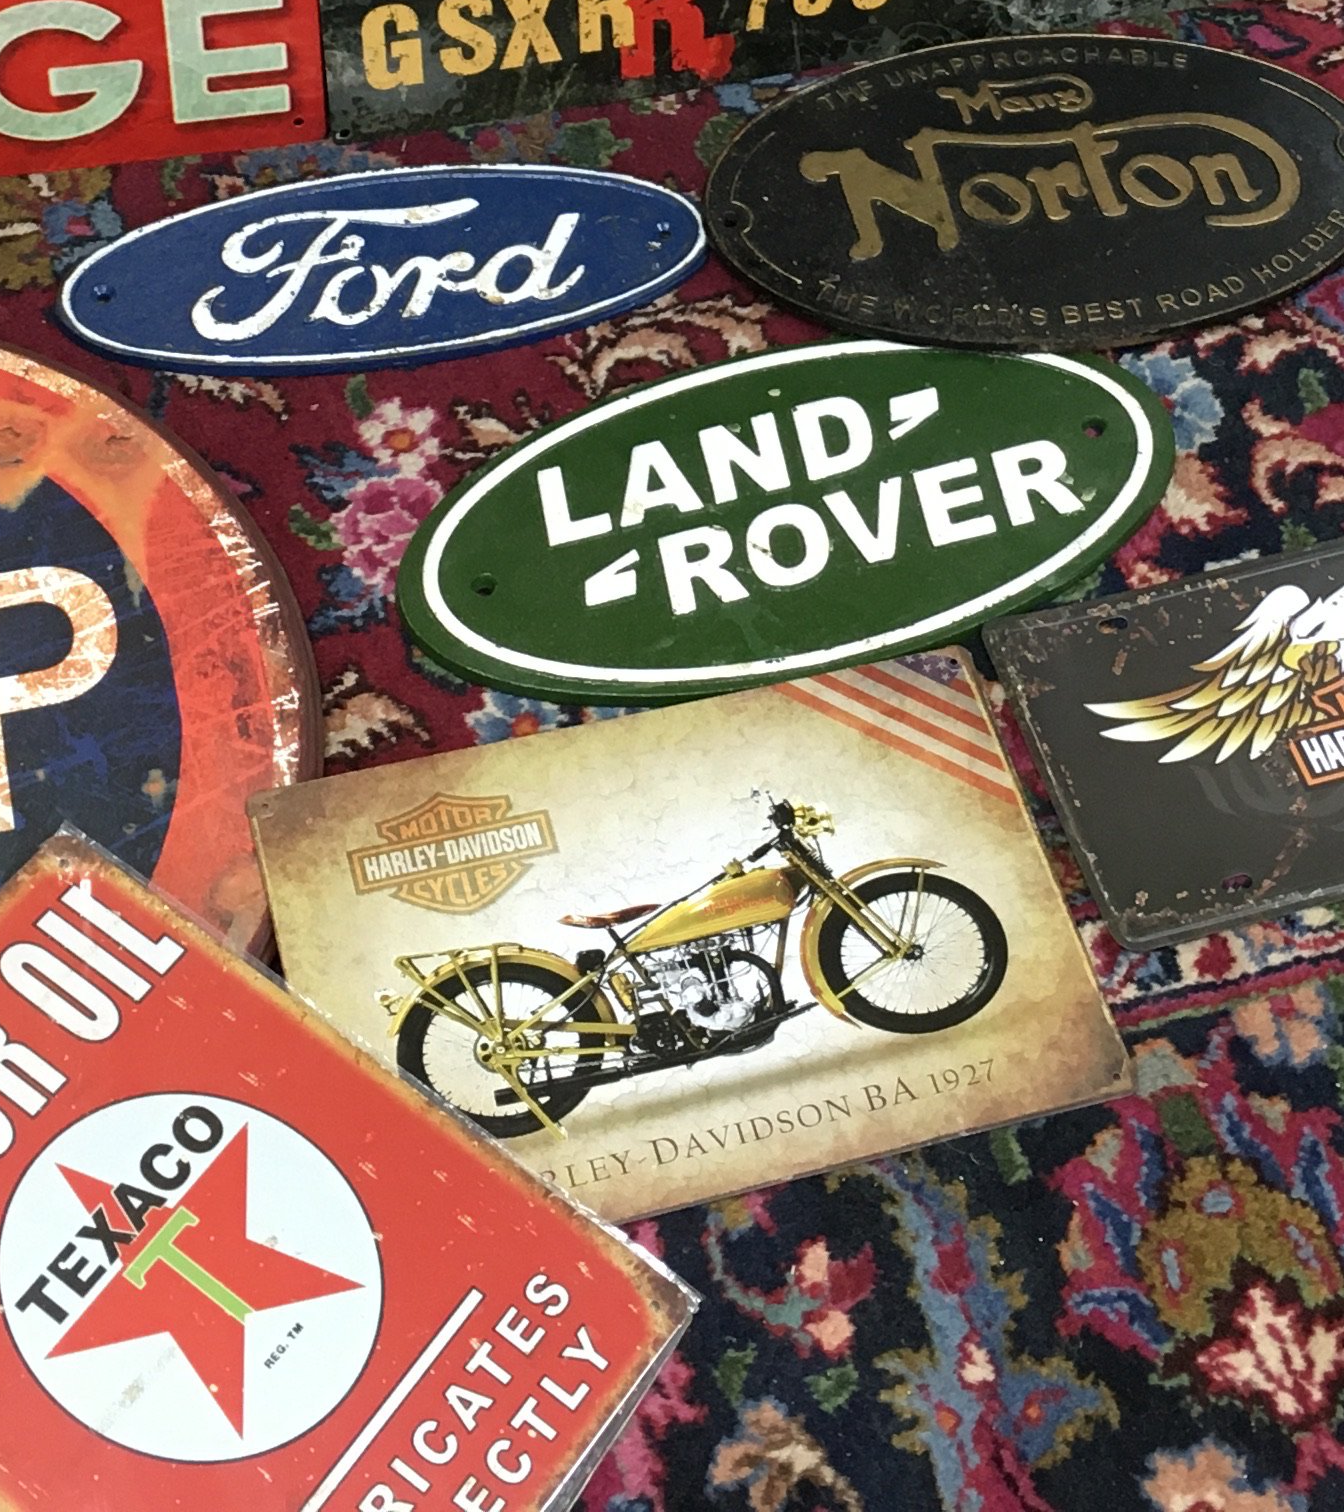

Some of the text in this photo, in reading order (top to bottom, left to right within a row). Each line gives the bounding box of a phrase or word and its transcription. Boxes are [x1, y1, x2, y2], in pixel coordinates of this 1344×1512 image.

[815, 46, 1188, 112] THE UNAPPROACHABLE
[935, 72, 1095, 126] Manx
[797, 111, 1302, 262] Norton
[190, 196, 586, 343] Ford
[813, 274, 879, 316] THE
[892, 298, 1048, 328] WORLD'S
[1060, 297, 1144, 326] BEST
[1159, 273, 1247, 315] ROAD
[536, 394, 874, 548] LAND
[657, 438, 1087, 616] ROVER
[362, 820, 543, 883] HARLEY-DAVIDSON
[399, 804, 493, 840] MOTOR
[412, 862, 508, 906] CYCLES
[862, 1075, 919, 1114] BA
[926, 1056, 996, 1097] 1927
[13, 1104, 226, 1326] TEXACO
[262, 1321, 305, 1371] REG. TM
